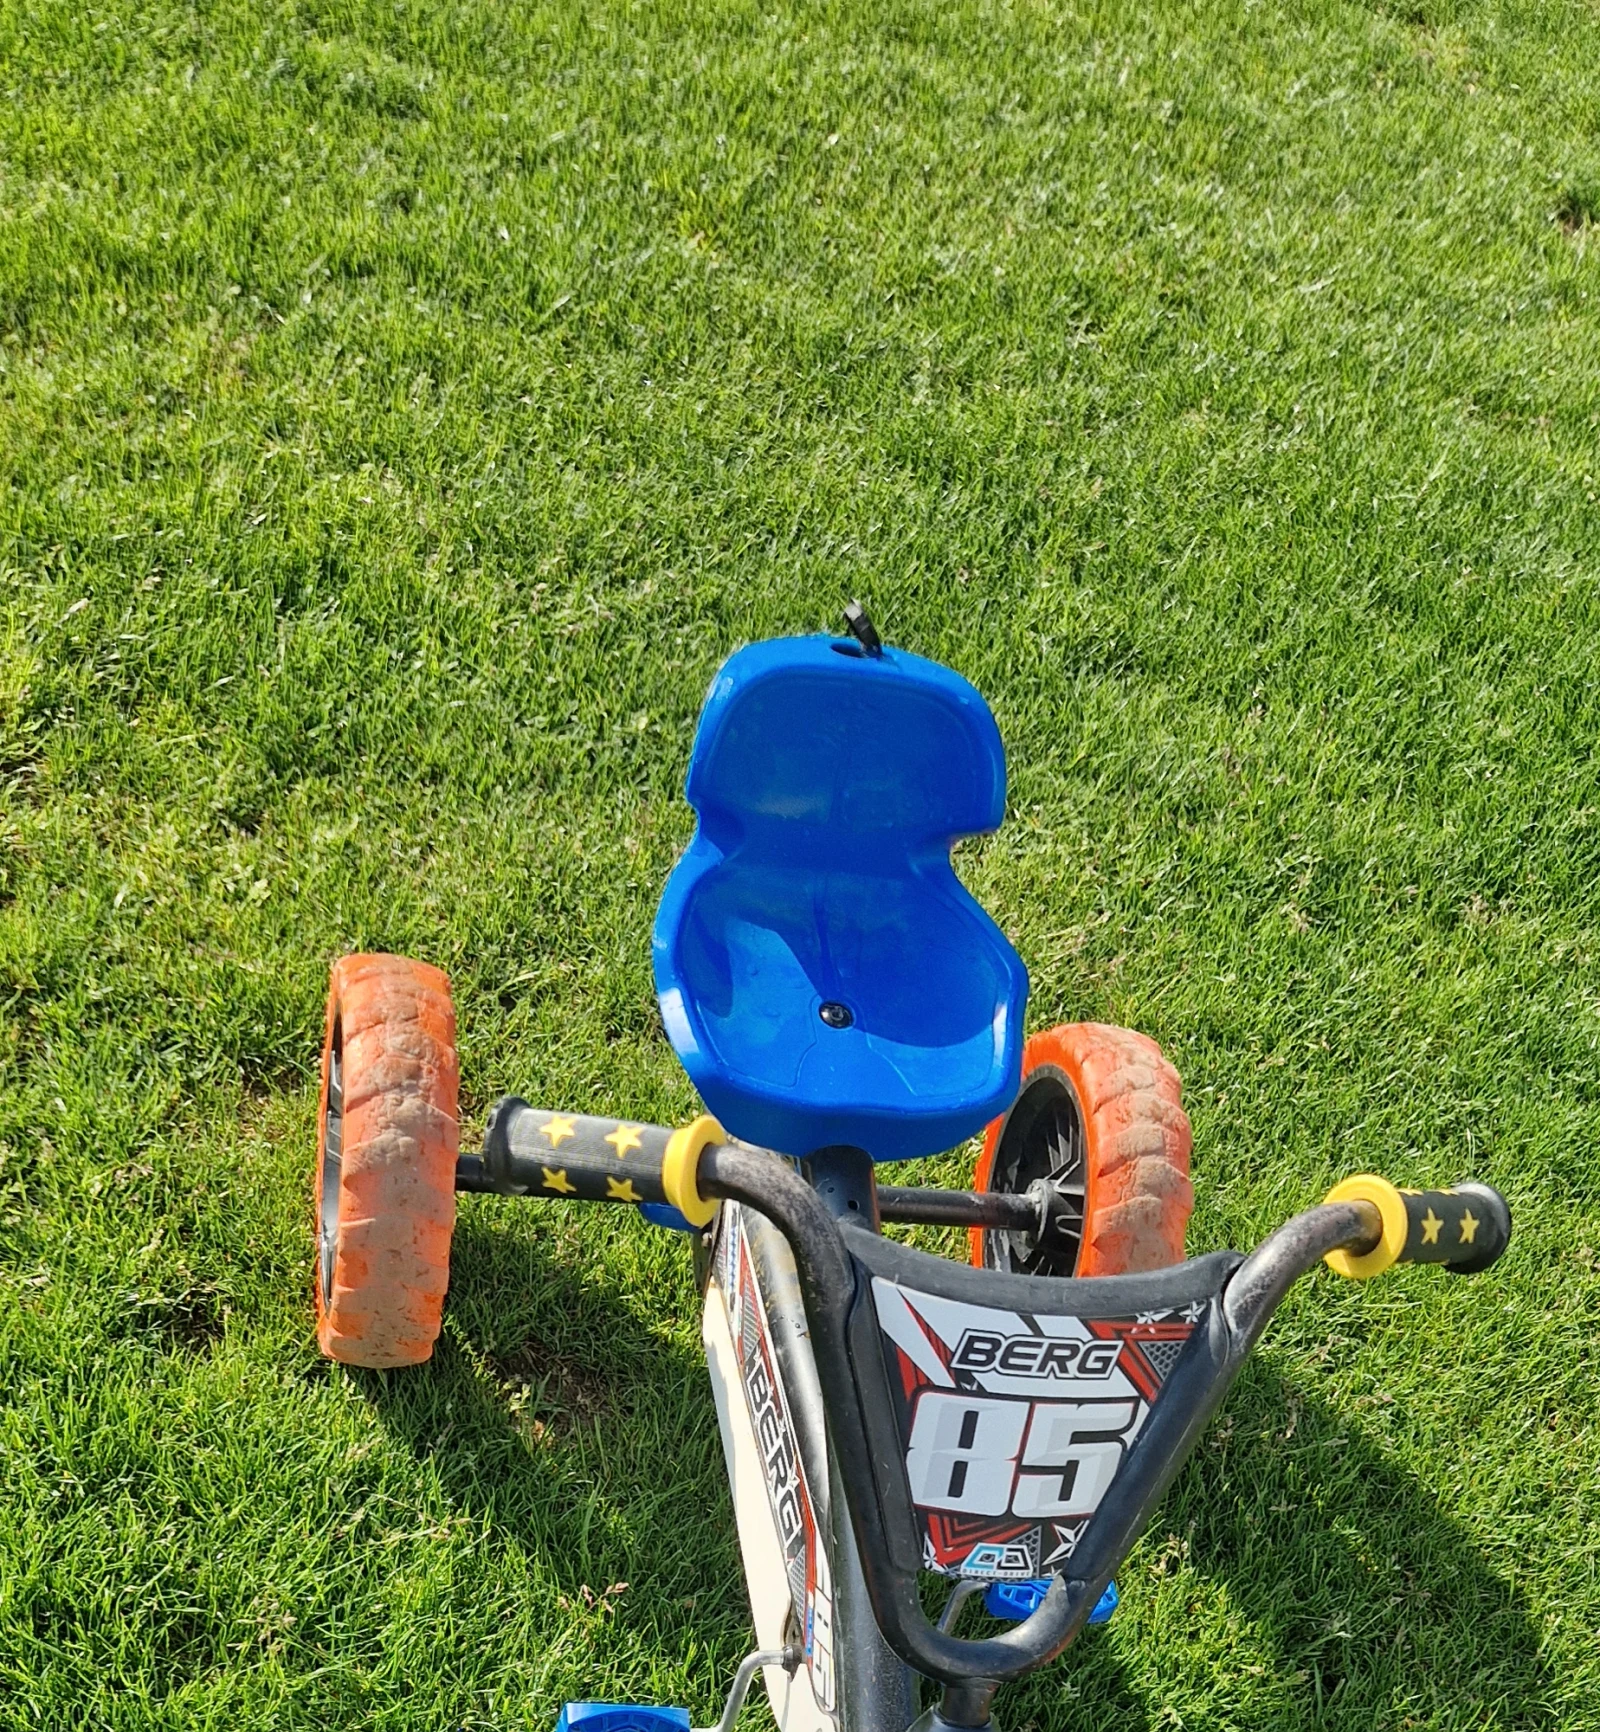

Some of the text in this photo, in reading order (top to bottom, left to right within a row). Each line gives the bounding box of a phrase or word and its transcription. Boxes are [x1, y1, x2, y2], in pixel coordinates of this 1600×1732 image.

[954, 1332, 1121, 1377] BERG
[748, 1358, 801, 1547] BERG
[906, 1391, 1135, 1518] 85
